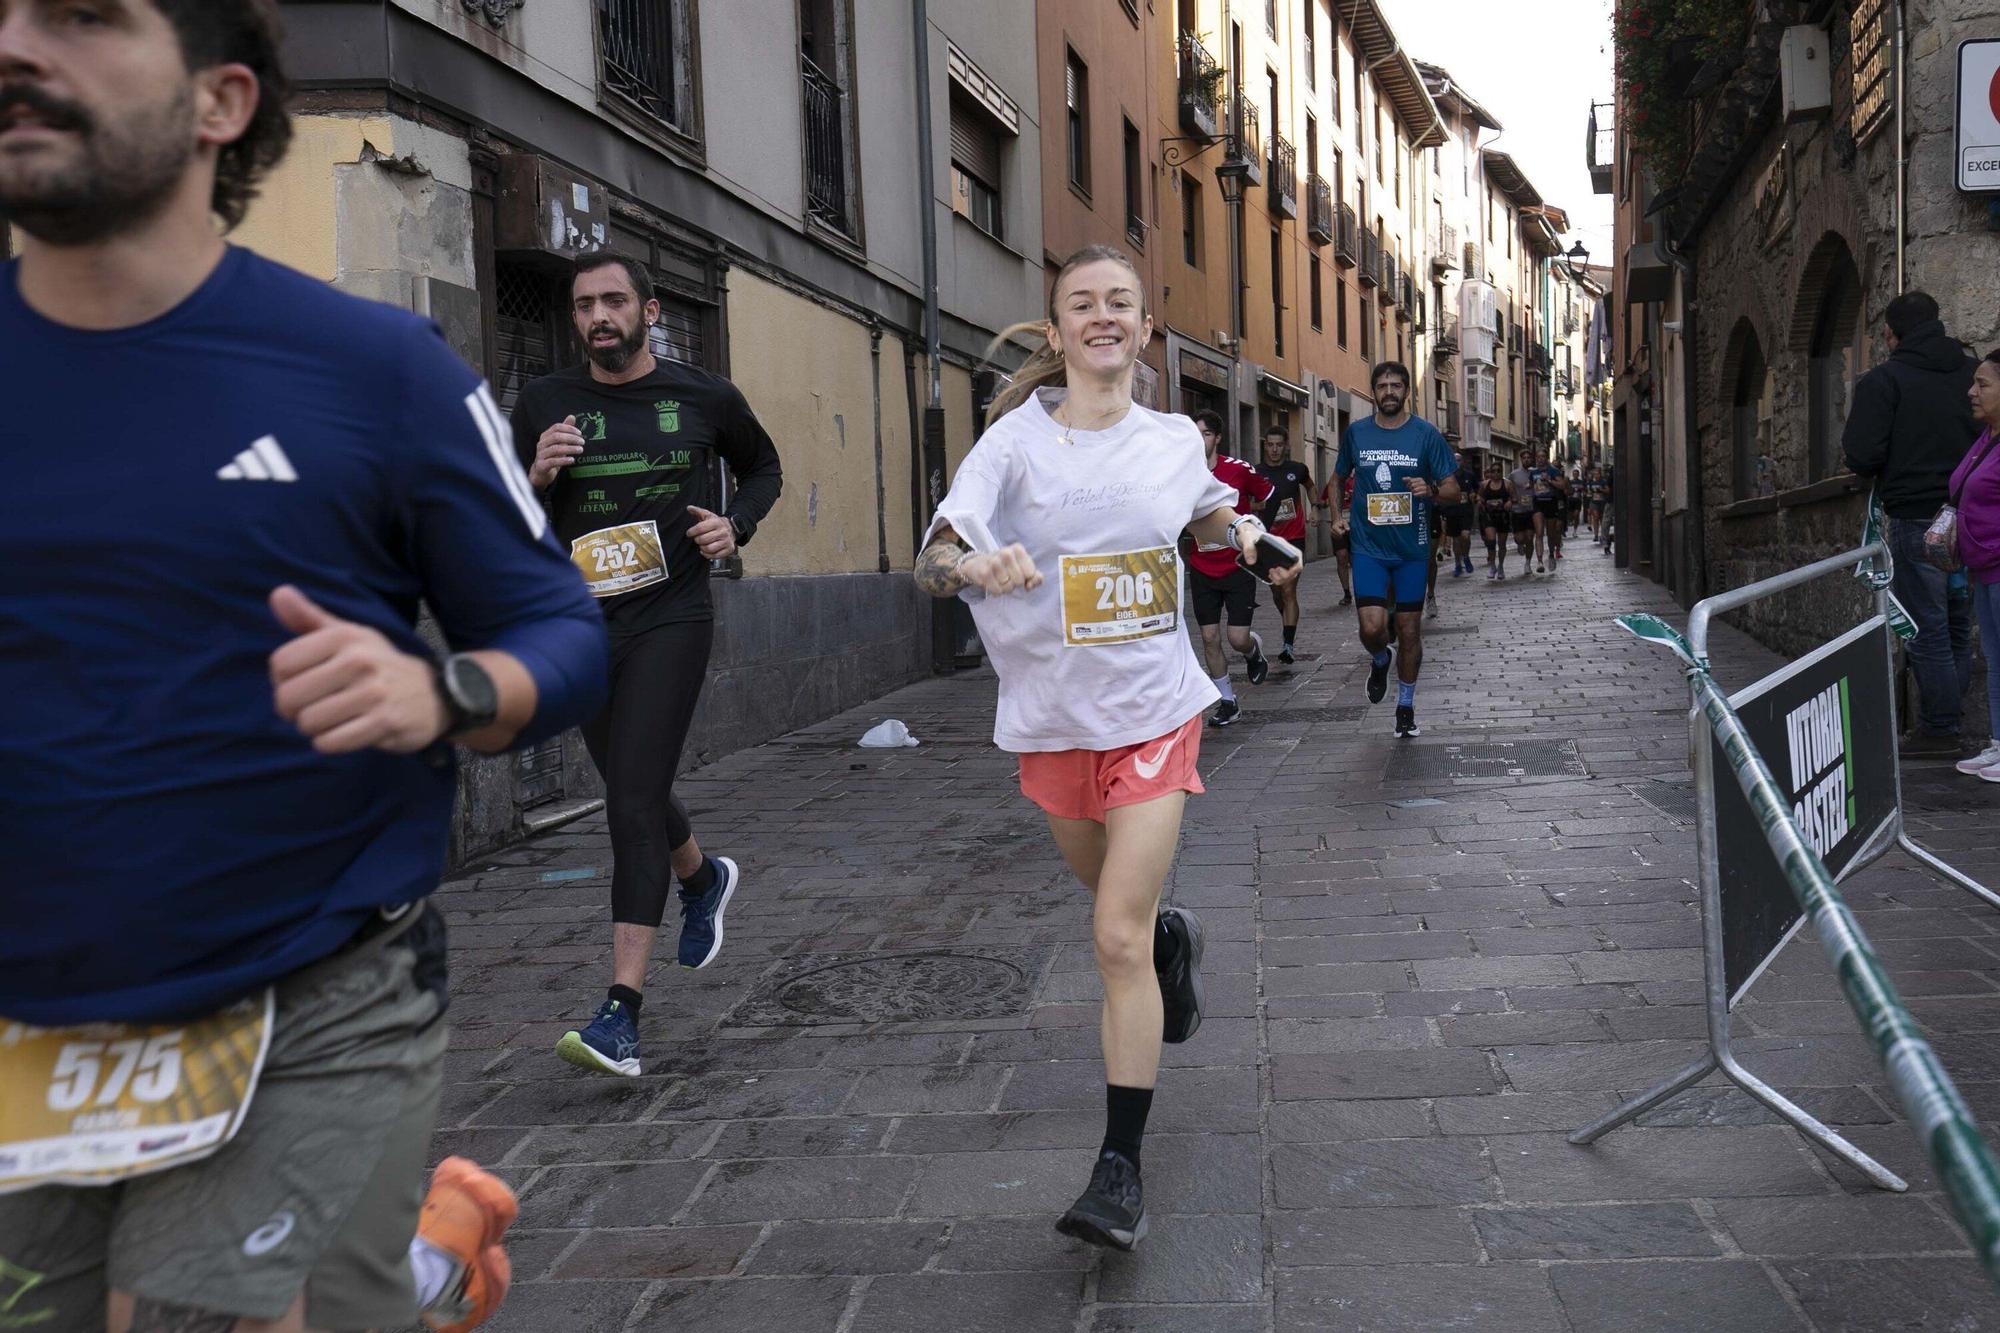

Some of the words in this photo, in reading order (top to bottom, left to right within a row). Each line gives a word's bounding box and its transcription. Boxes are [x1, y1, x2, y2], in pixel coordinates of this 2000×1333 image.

[670, 450, 691, 464] 10K
[1380, 501, 1400, 513] 221
[591, 541, 639, 573] 252
[1095, 571, 1154, 611] 206
[1116, 610, 1138, 620] EIDER
[1785, 682, 1845, 794] VITORIA
[46, 1028, 185, 1112] 575
